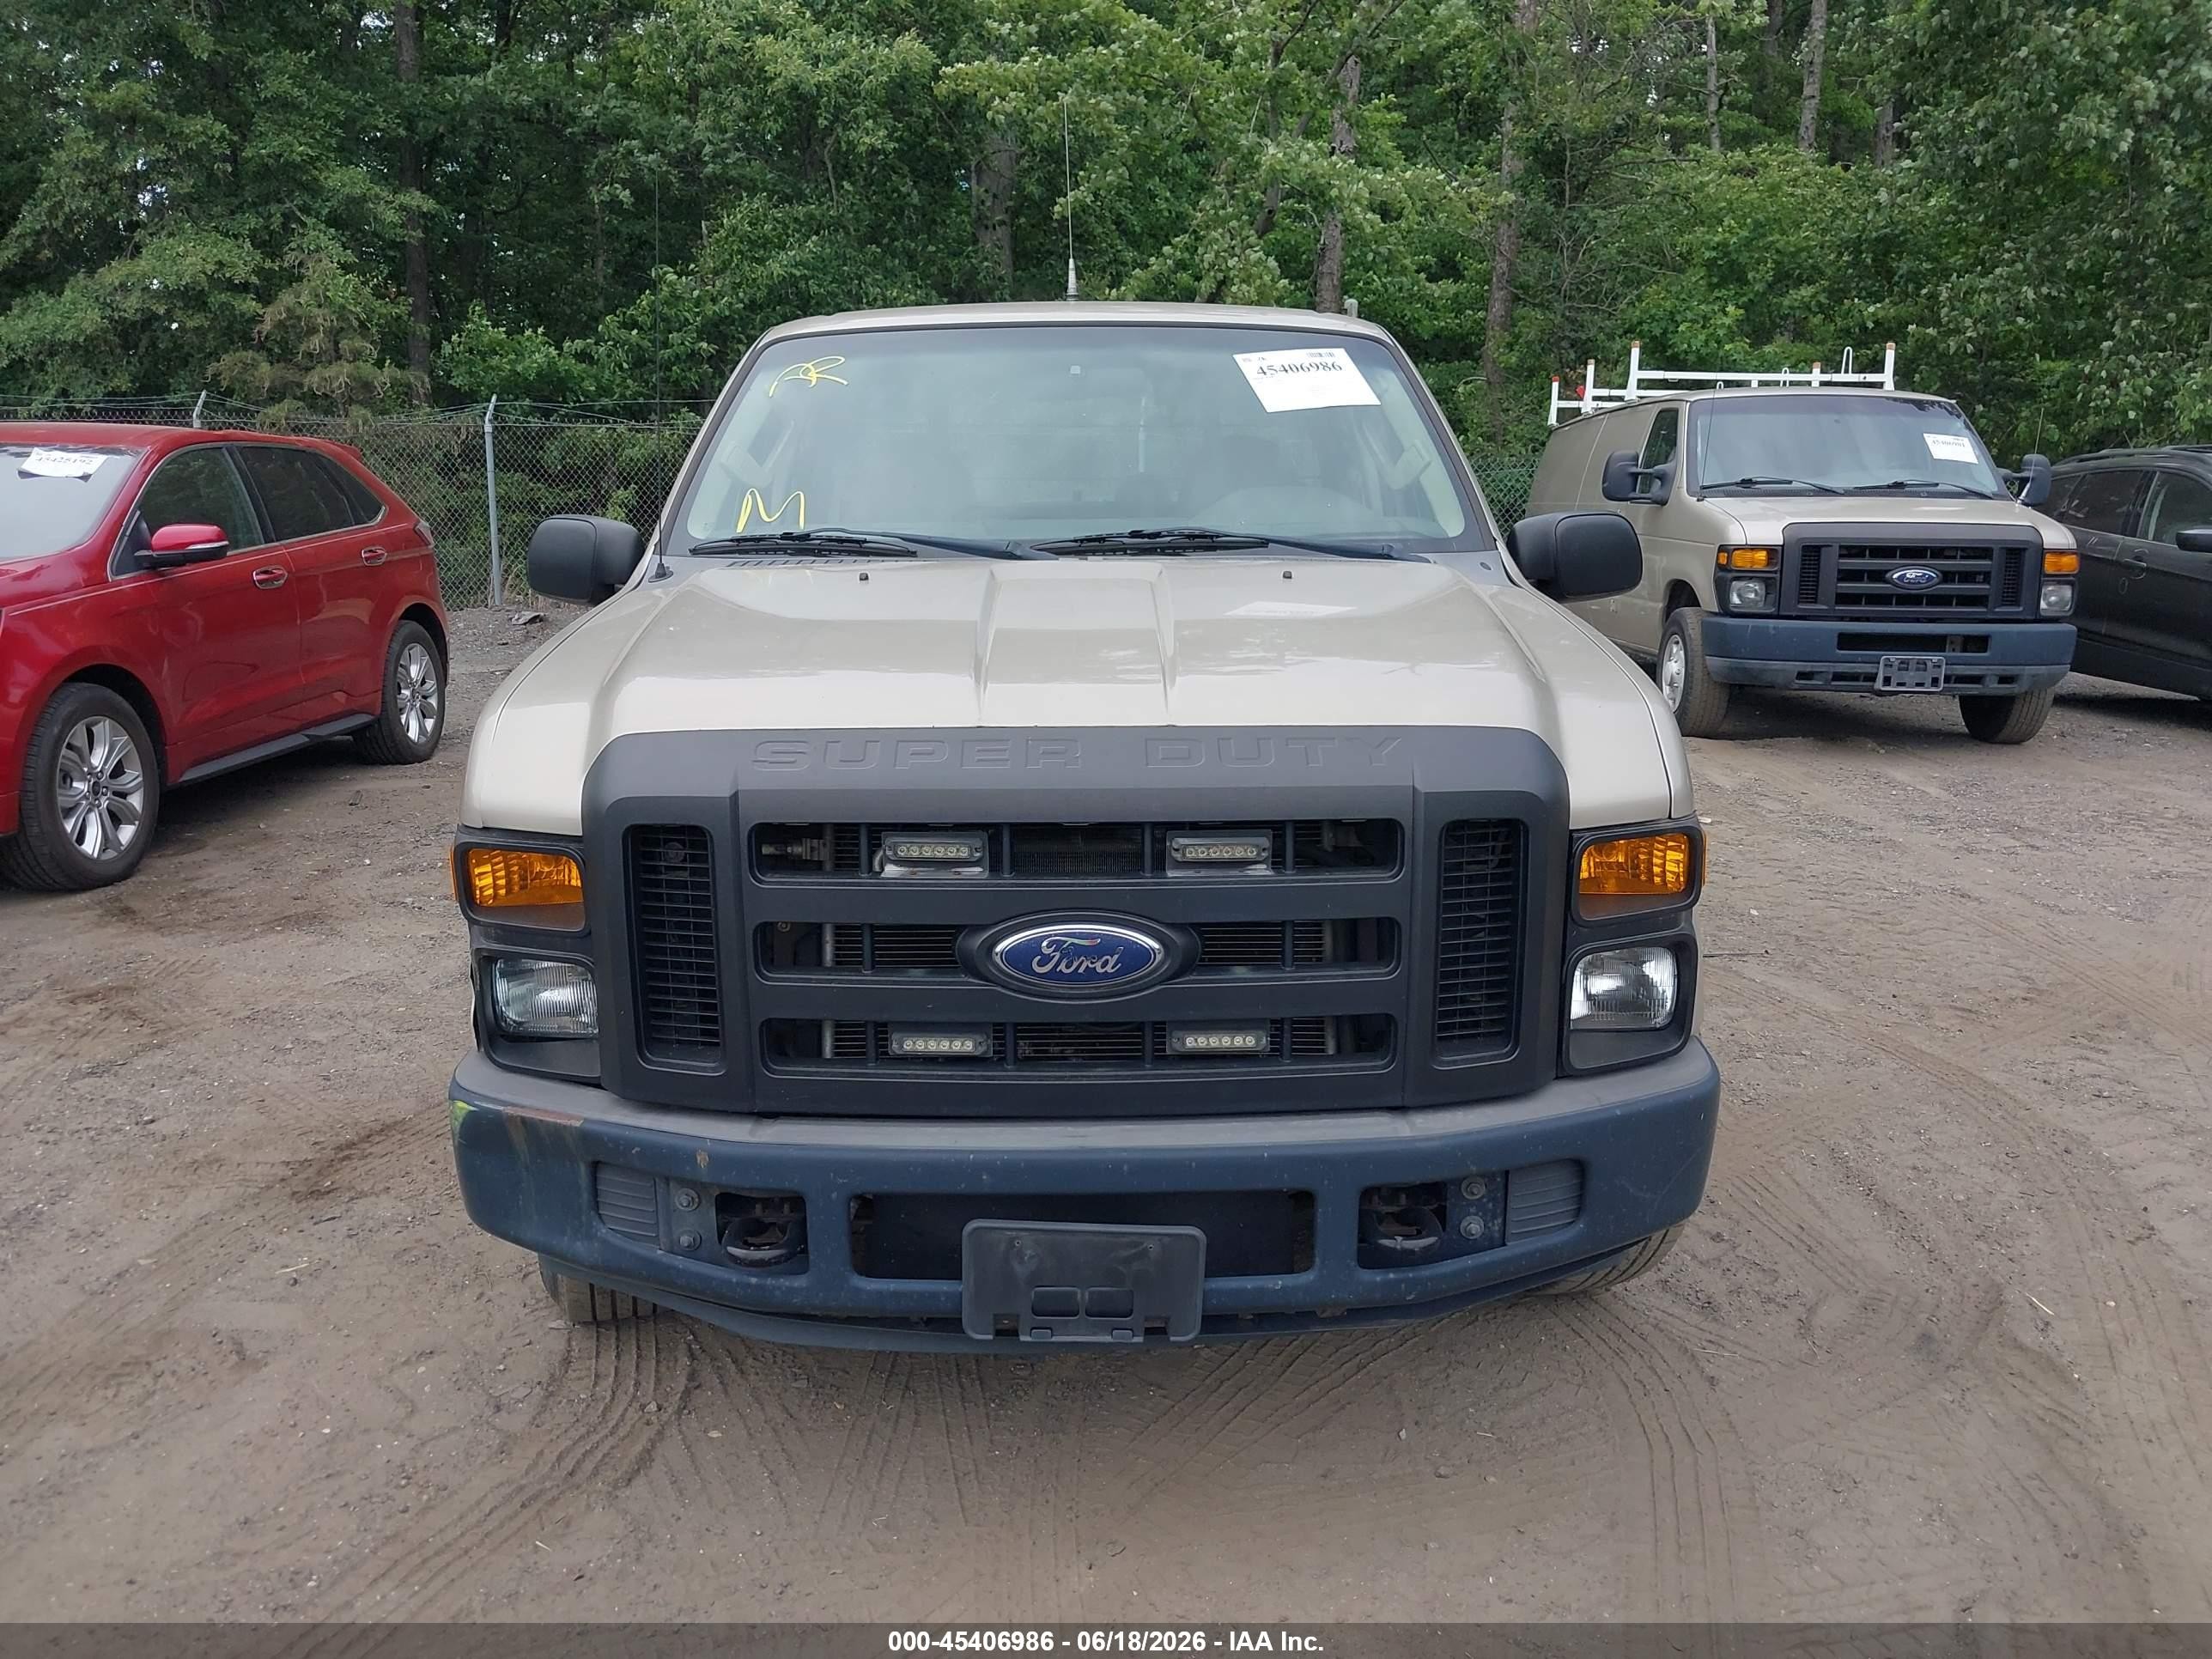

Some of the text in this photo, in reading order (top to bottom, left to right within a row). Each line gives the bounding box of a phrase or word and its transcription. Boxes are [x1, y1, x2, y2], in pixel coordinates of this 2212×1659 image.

[1256, 361, 1343, 377] 45406986
[750, 737, 1403, 771] SUPER DUTY
[1031, 935, 1124, 975] Ford
